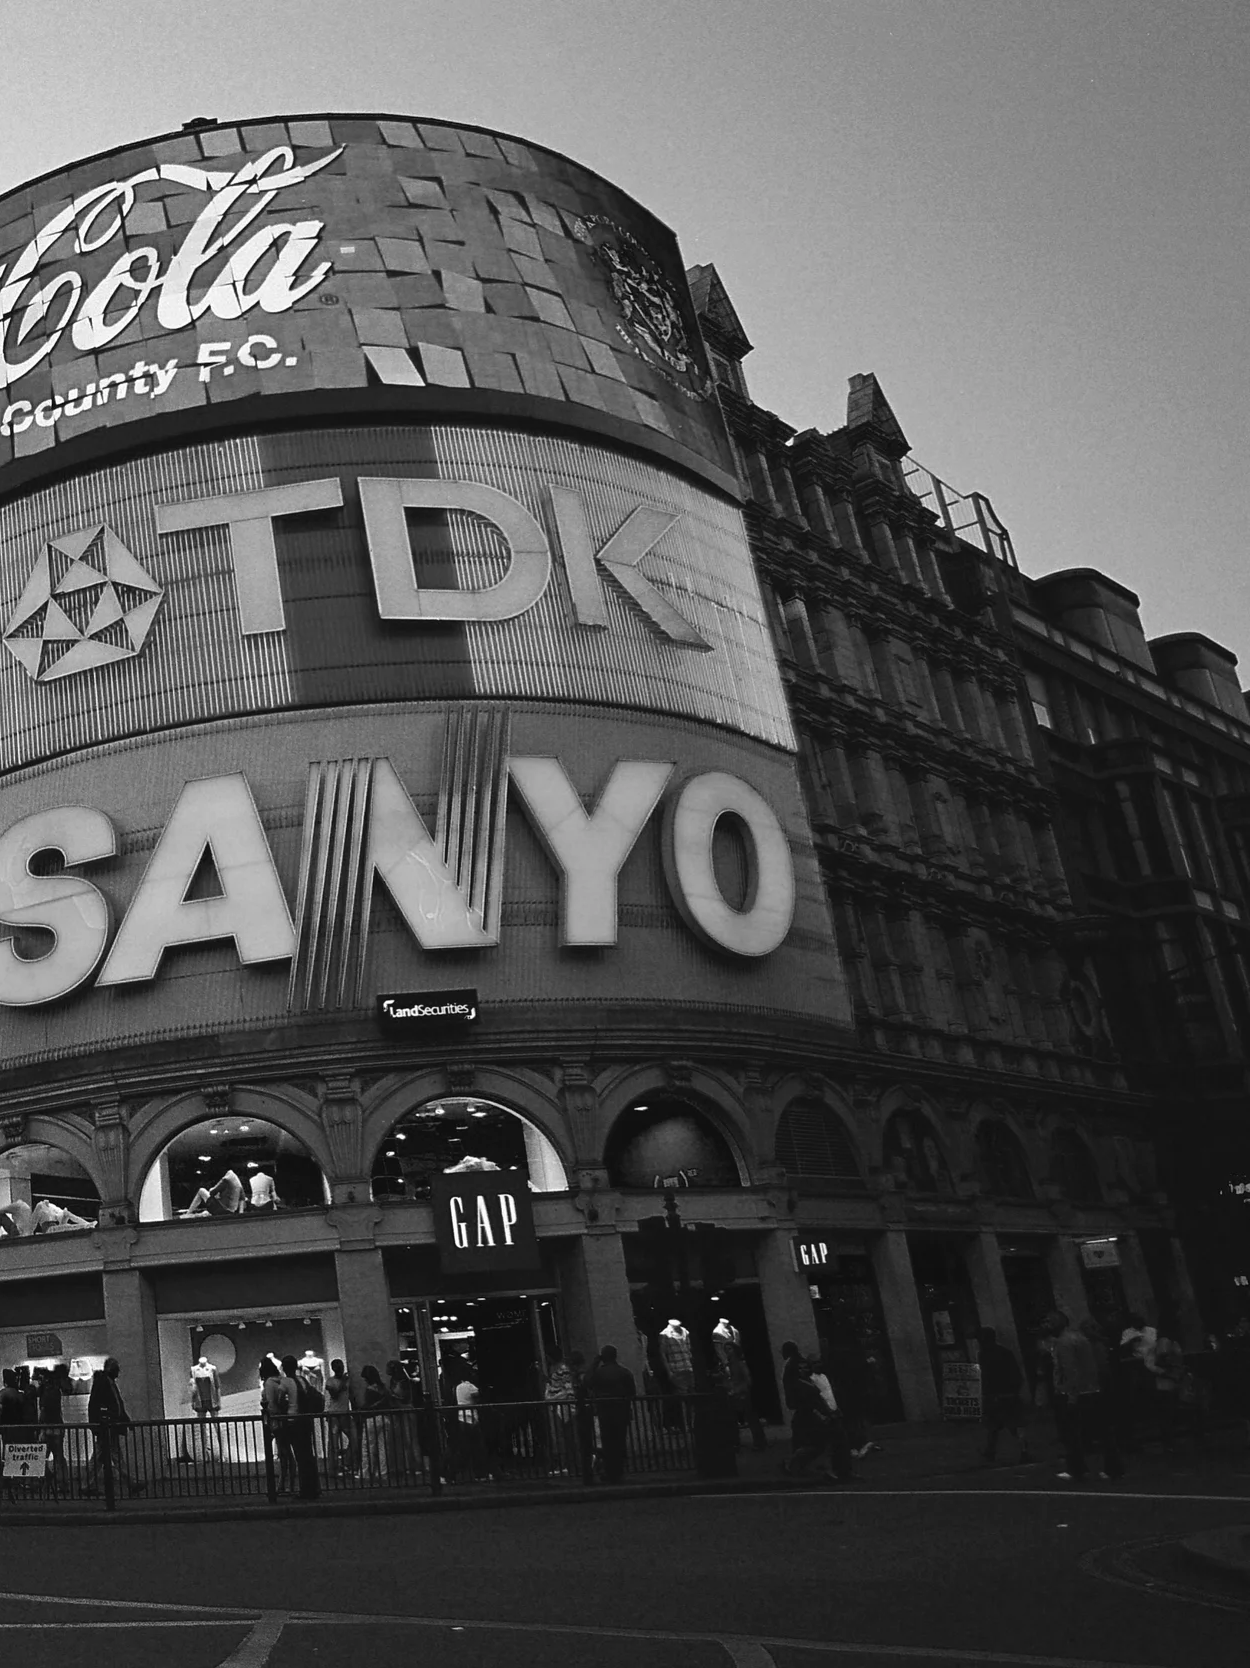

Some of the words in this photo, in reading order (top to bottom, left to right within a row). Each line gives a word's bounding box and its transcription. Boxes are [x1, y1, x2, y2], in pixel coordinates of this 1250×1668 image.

[0, 356, 179, 437] County
[196, 334, 299, 383] F.C.
[155, 476, 714, 651] TDK
[449, 1193, 517, 1249] GAP
[800, 1242, 828, 1266] GAP
[8, 1445, 44, 1453] Diverted
[12, 1453, 40, 1461] traffic
